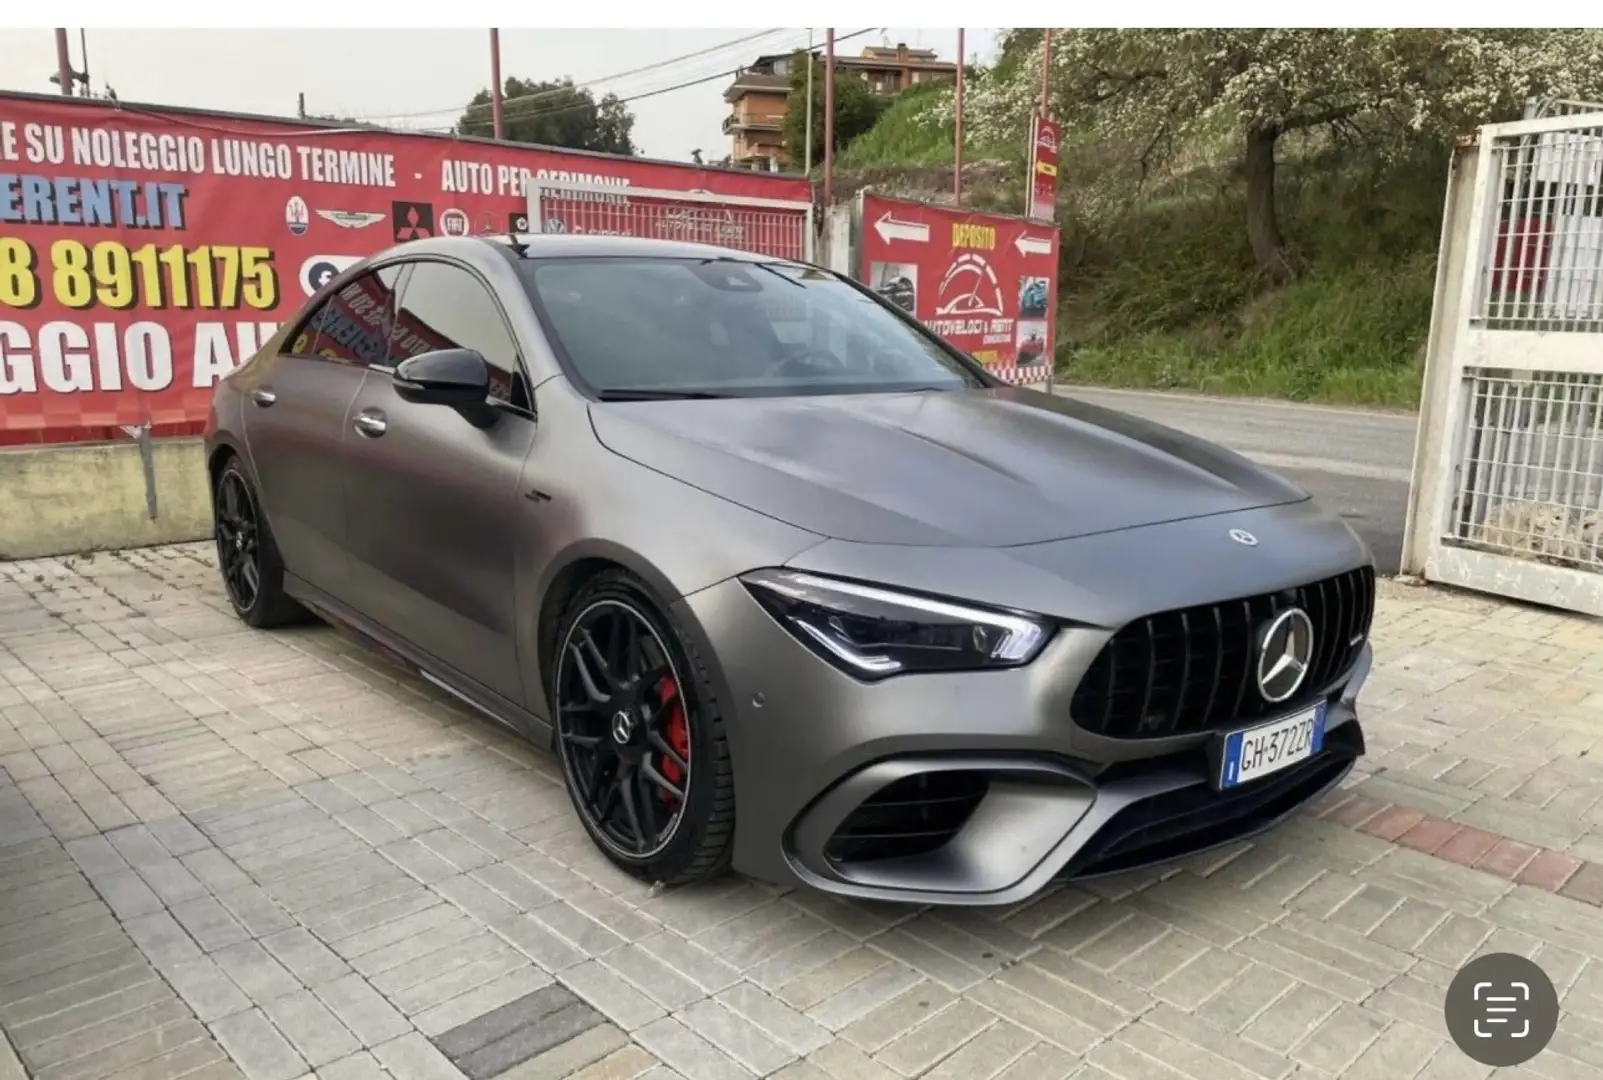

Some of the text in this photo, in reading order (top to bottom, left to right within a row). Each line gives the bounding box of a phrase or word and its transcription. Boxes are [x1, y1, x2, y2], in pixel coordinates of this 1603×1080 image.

[0, 121, 19, 161] E
[24, 123, 65, 164] SU
[71, 127, 205, 174] NOLEGGIO
[211, 138, 292, 180] LUNGO
[297, 145, 396, 187] TERMINE
[441, 160, 493, 195] AUTO
[0, 173, 187, 229] ERENT.IT
[952, 222, 996, 250] DEPOSITO
[0, 236, 276, 310] 8 8911175
[192, 321, 285, 388] AU
